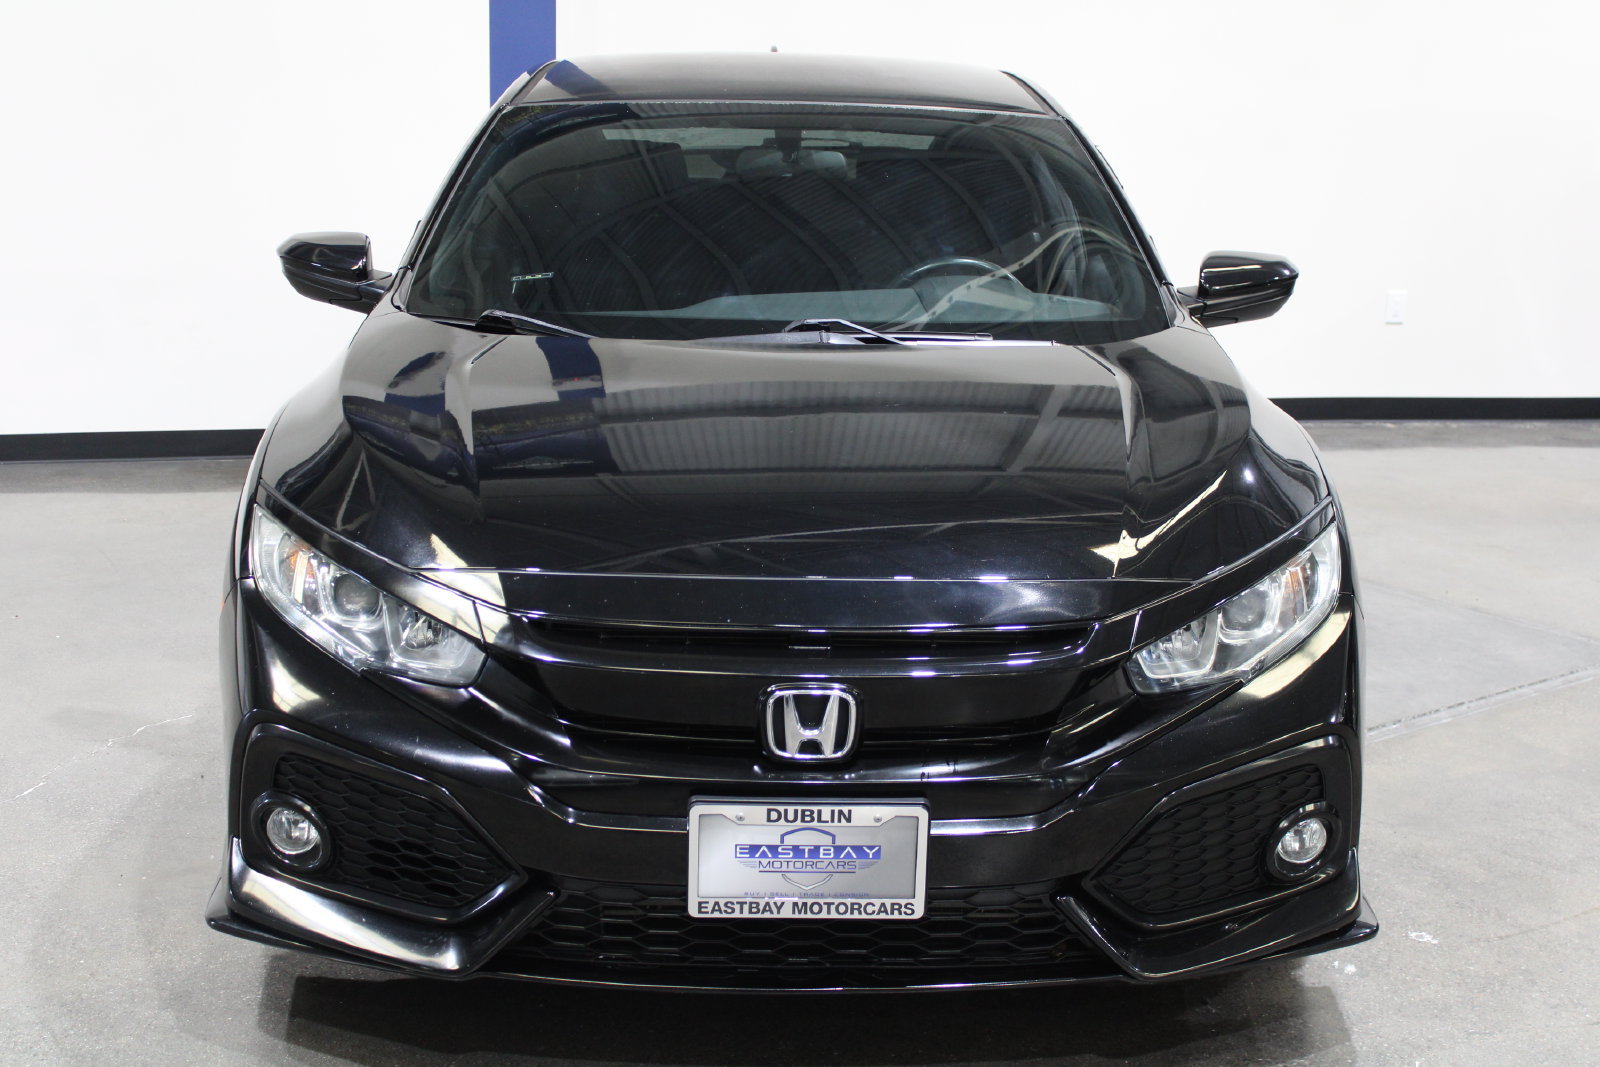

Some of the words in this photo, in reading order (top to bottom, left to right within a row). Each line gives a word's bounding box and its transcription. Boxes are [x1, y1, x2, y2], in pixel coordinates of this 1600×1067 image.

[766, 808, 852, 824] DUBLIN
[736, 845, 880, 859] EASTBAY
[758, 860, 857, 870] MOTORCARS
[697, 901, 785, 915] EASTBAY
[791, 902, 915, 916] MOTORCARS
